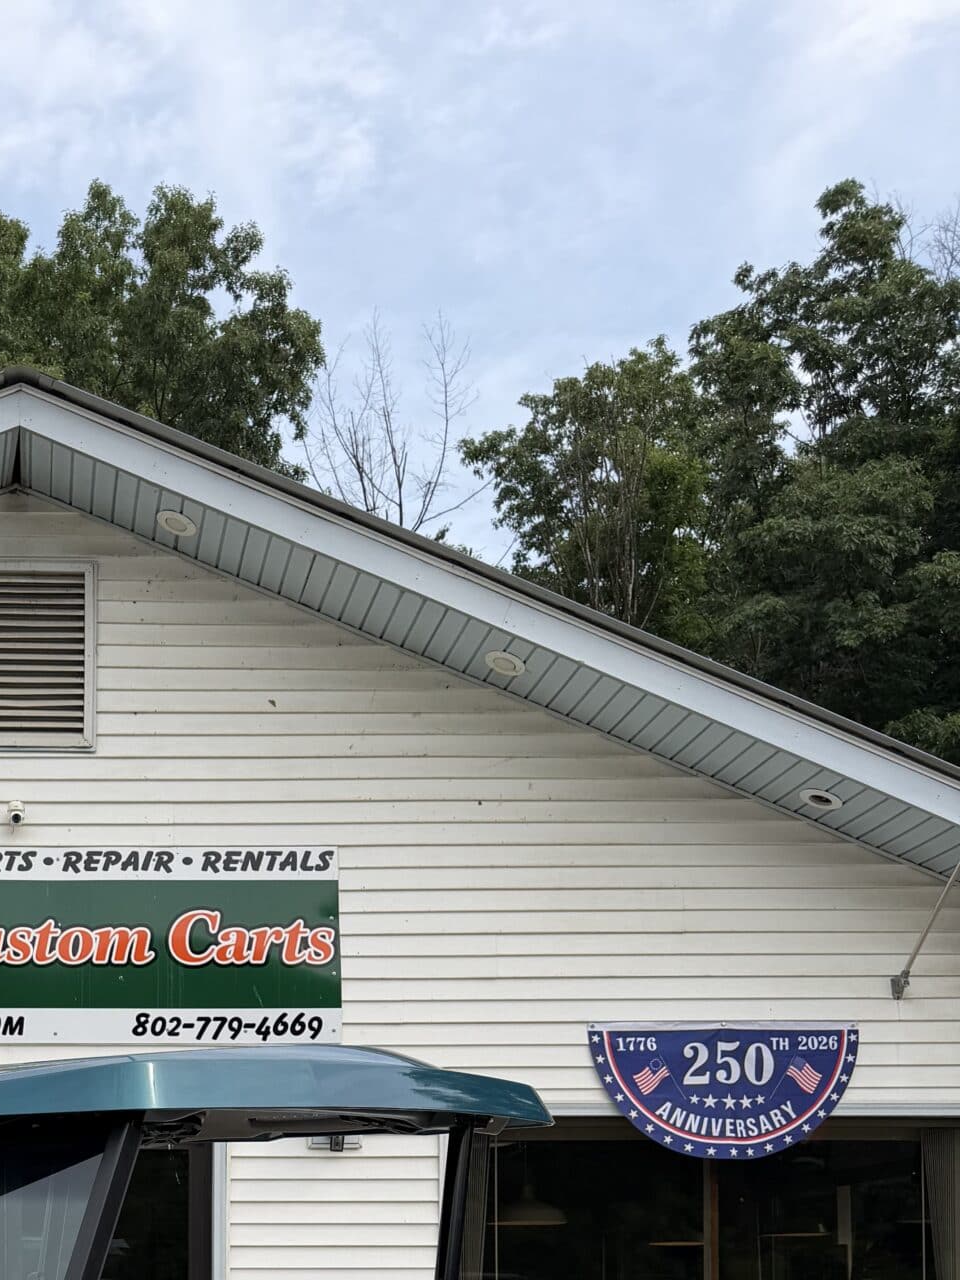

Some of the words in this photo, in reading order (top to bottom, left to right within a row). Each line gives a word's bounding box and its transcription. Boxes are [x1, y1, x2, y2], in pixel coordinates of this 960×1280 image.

[61, 850, 175, 874] REPAIR
[200, 850, 334, 874] RENTALS
[168, 909, 336, 966] Carts
[131, 1012, 323, 1041] 802-779-4669
[616, 1037, 657, 1051] 1776
[797, 1036, 838, 1050] 2026
[654, 1101, 797, 1138] ANNIVERSARY
